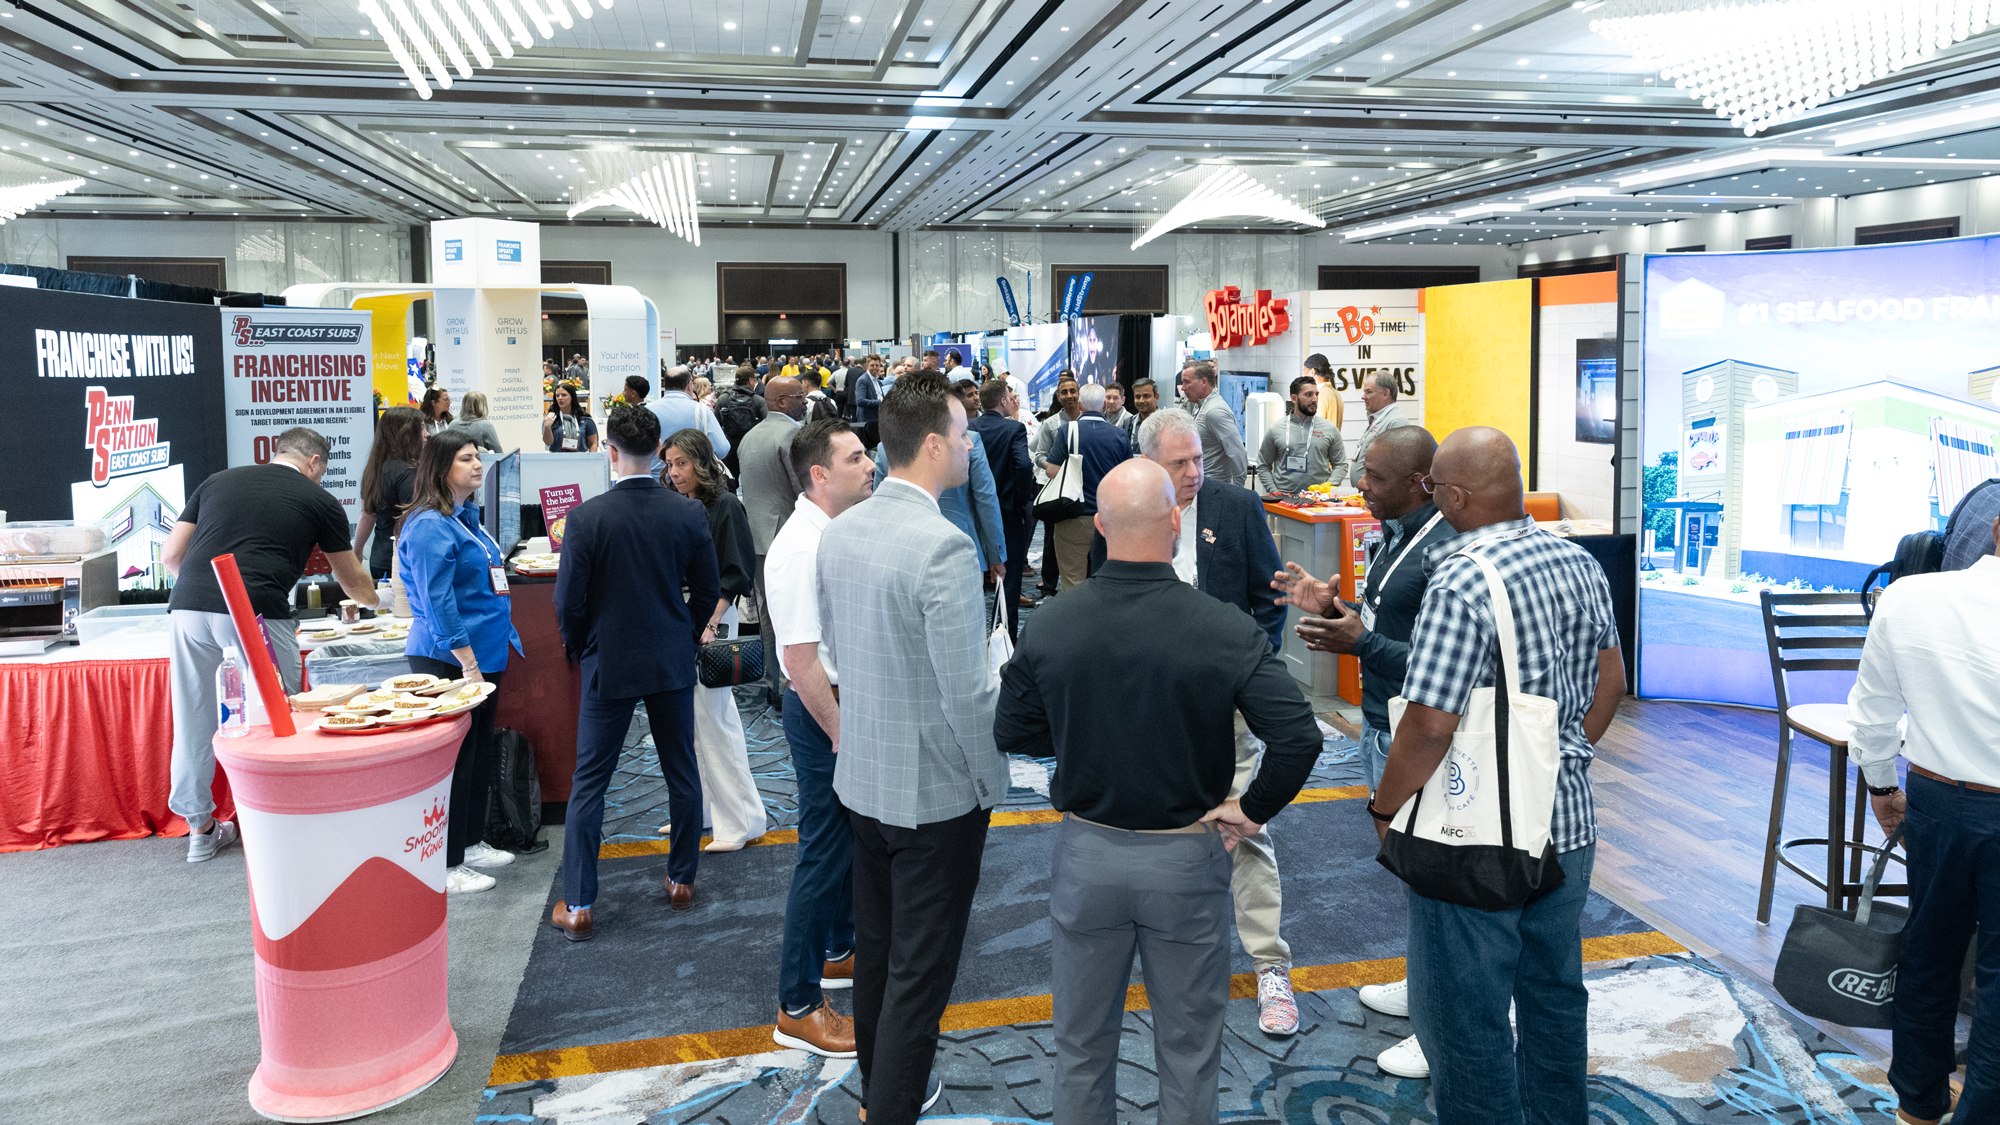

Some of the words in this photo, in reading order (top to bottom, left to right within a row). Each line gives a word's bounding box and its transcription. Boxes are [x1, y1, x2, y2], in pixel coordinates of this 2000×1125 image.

[1203, 288, 1278, 350] Bojangles
[1737, 303, 1768, 324] #1
[1776, 298, 1925, 323] SEAFOOD
[255, 328, 286, 338] EAST
[286, 328, 325, 338] COAST
[1324, 322, 1340, 332] IT'S
[1337, 306, 1374, 344] Bo
[1380, 322, 1406, 332] TIME!
[35, 328, 131, 378] FRANCHISE
[131, 334, 171, 377] WITH
[171, 335, 195, 375] US!
[601, 351, 619, 359] Your
[620, 351, 640, 359] Next
[1358, 345, 1371, 359] IN
[233, 354, 366, 377] FRANCHISING
[251, 379, 351, 402] INCENTIVE
[1329, 368, 1349, 392] AS
[1352, 368, 1415, 396] VAS
[88, 390, 132, 445] PENN
[338, 435, 350, 445] for
[94, 422, 156, 482] STATION
[111, 454, 129, 469] EAST
[129, 451, 150, 467] COAST
[150, 447, 167, 463] SUBS
[328, 450, 352, 460] onths
[327, 467, 346, 475] Initial
